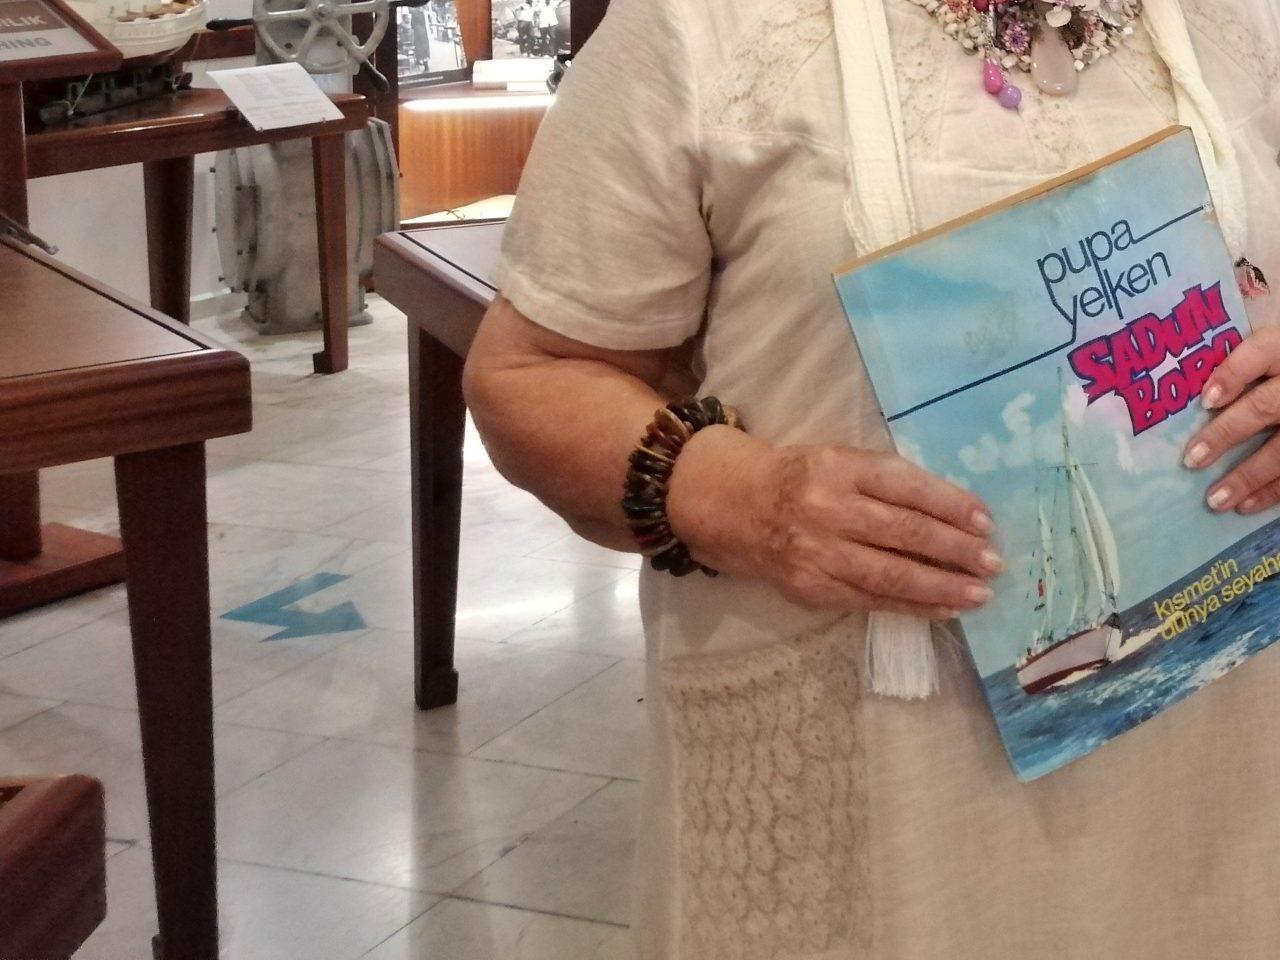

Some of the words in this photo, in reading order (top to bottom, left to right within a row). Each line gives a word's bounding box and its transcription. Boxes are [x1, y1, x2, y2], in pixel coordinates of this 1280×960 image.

[1037, 219, 1140, 290] pupa
[1052, 251, 1172, 342] yelken
[1066, 280, 1231, 406] SADUN
